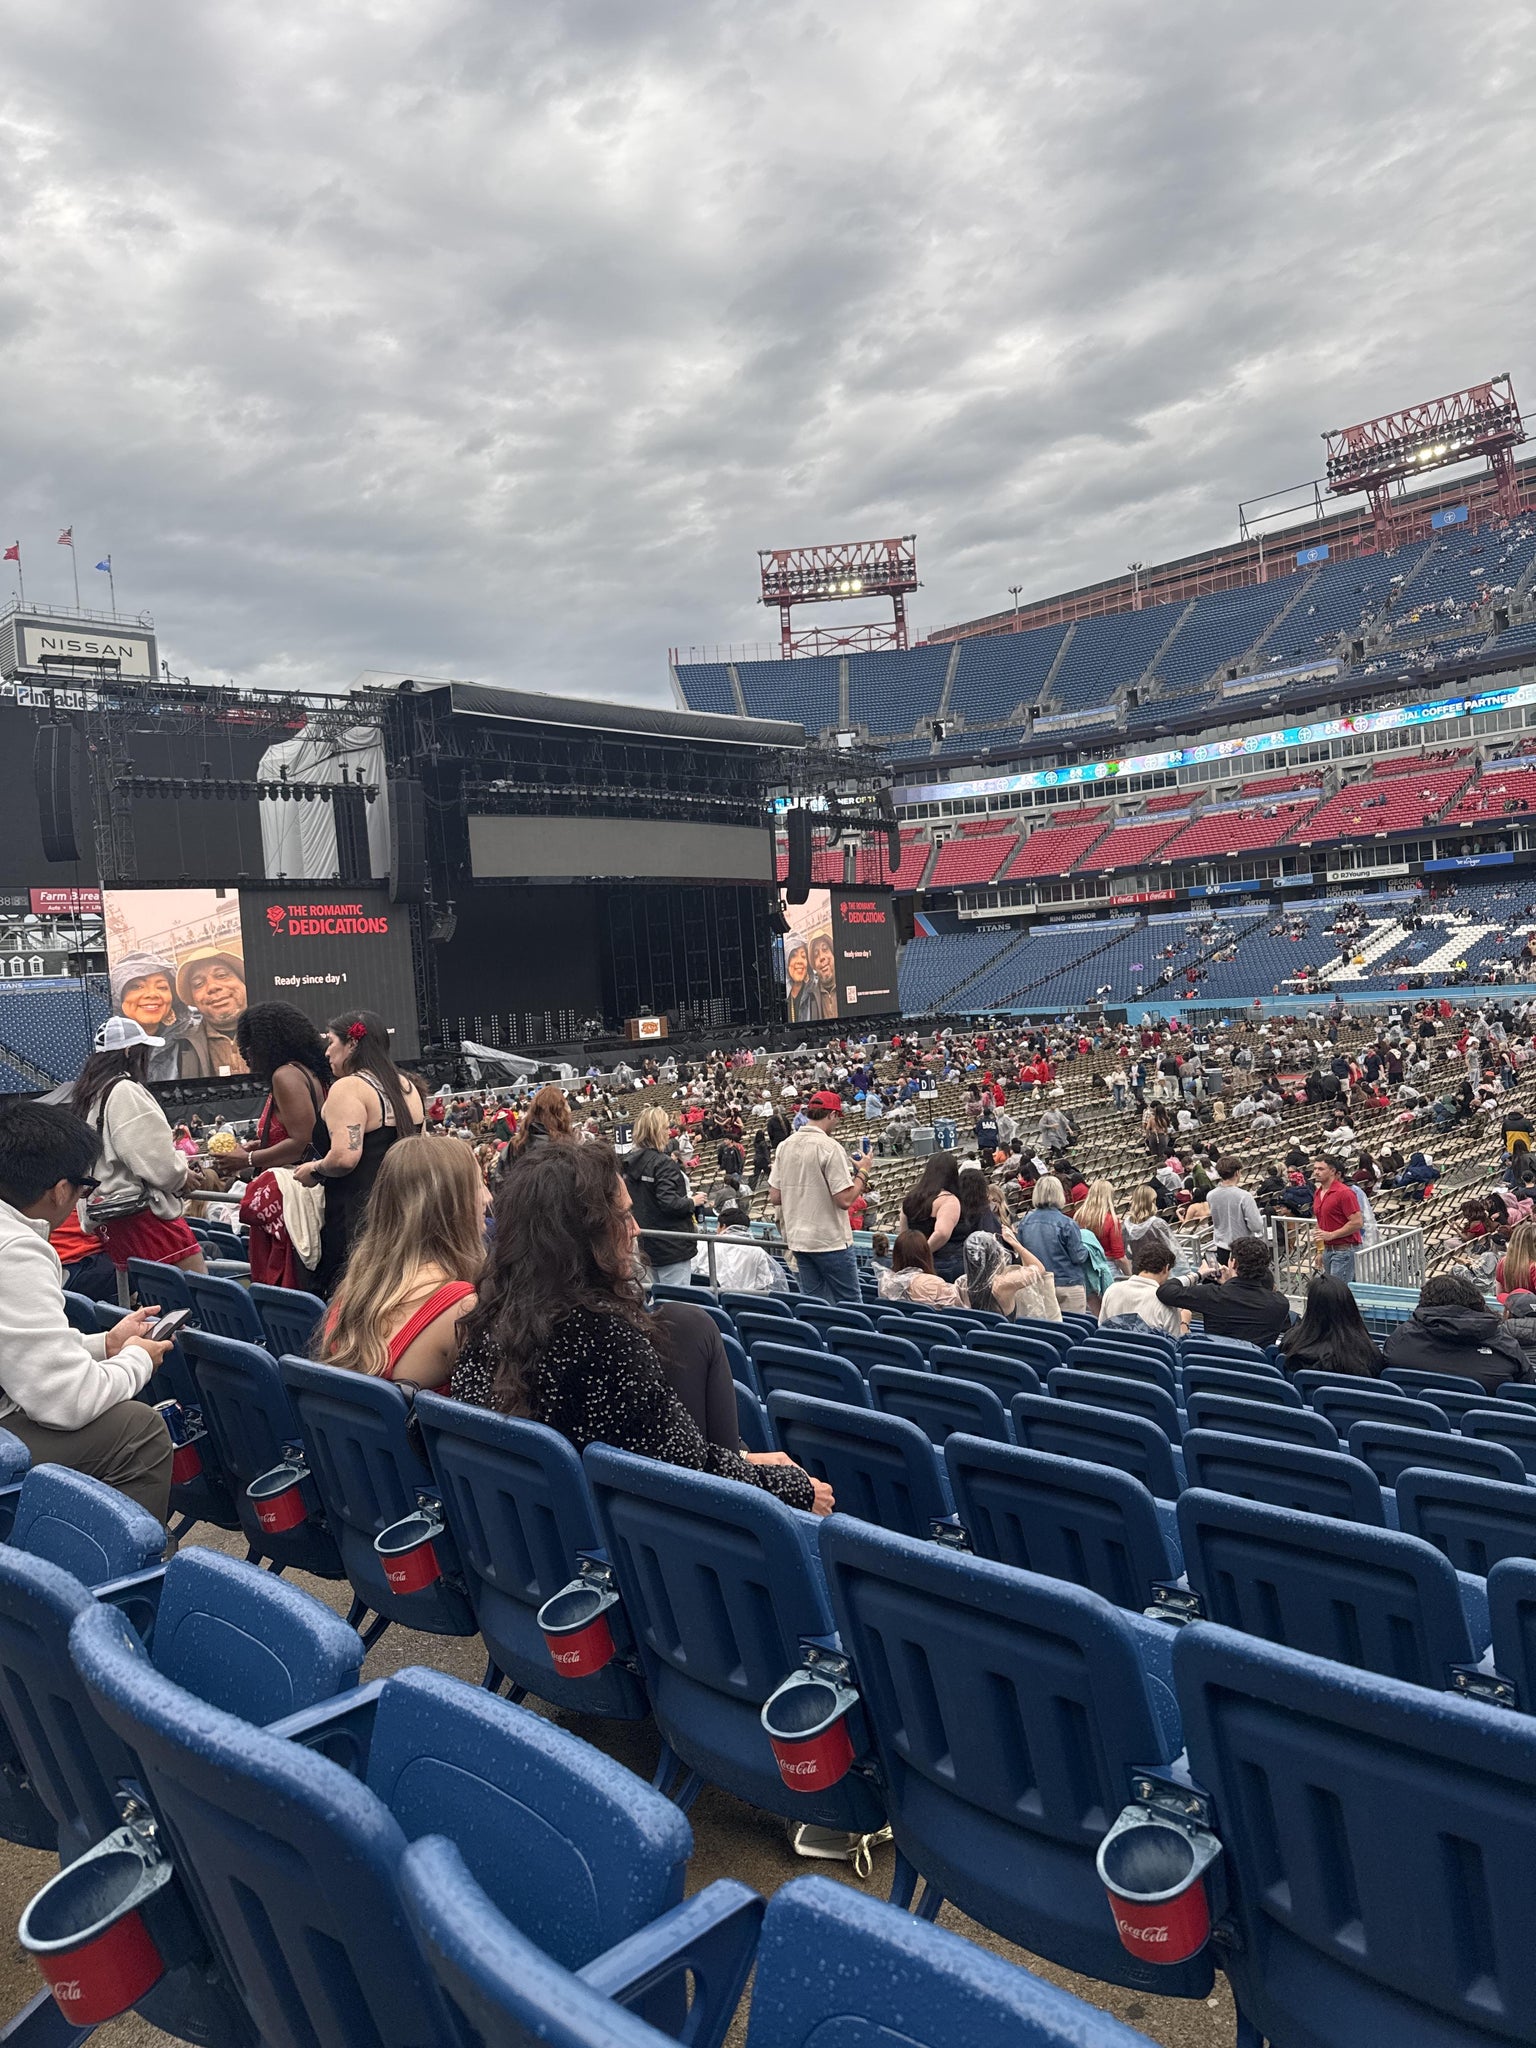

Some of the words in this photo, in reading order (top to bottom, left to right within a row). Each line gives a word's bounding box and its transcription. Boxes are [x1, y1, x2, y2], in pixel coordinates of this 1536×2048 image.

[41, 637, 132, 658] NISSAN
[1376, 712, 1419, 726] OFFICIAL
[1422, 702, 1463, 717] COFFEE
[1464, 693, 1514, 710] PARTNER
[1517, 688, 1533, 700] OF
[1326, 889, 1364, 898] HOUSTON
[1388, 884, 1417, 892] BLAND
[40, 892, 66, 900] Farm
[70, 891, 101, 900] Burea
[1150, 891, 1167, 900] Coca-Cola
[288, 906, 308, 916] THE
[310, 904, 363, 916] ROMANTIC
[848, 912, 886, 923] DEDICATIONS
[288, 917, 388, 936] DEDICATIONS
[976, 924, 1011, 933] TITANS
[274, 975, 300, 987] Ready
[302, 974, 323, 985] since
[325, 973, 340, 985] day
[342, 973, 347, 982] 1
[922, 1080, 927, 1089] D
[931, 1080, 935, 1089] D
[626, 1130, 632, 1142] E
[257, 1200, 281, 1221] 2026
[551, 1650, 580, 1664] Coca-Cola
[780, 1759, 817, 1775] Coca-Cola
[1120, 1920, 1168, 1942] Coca-Cola
